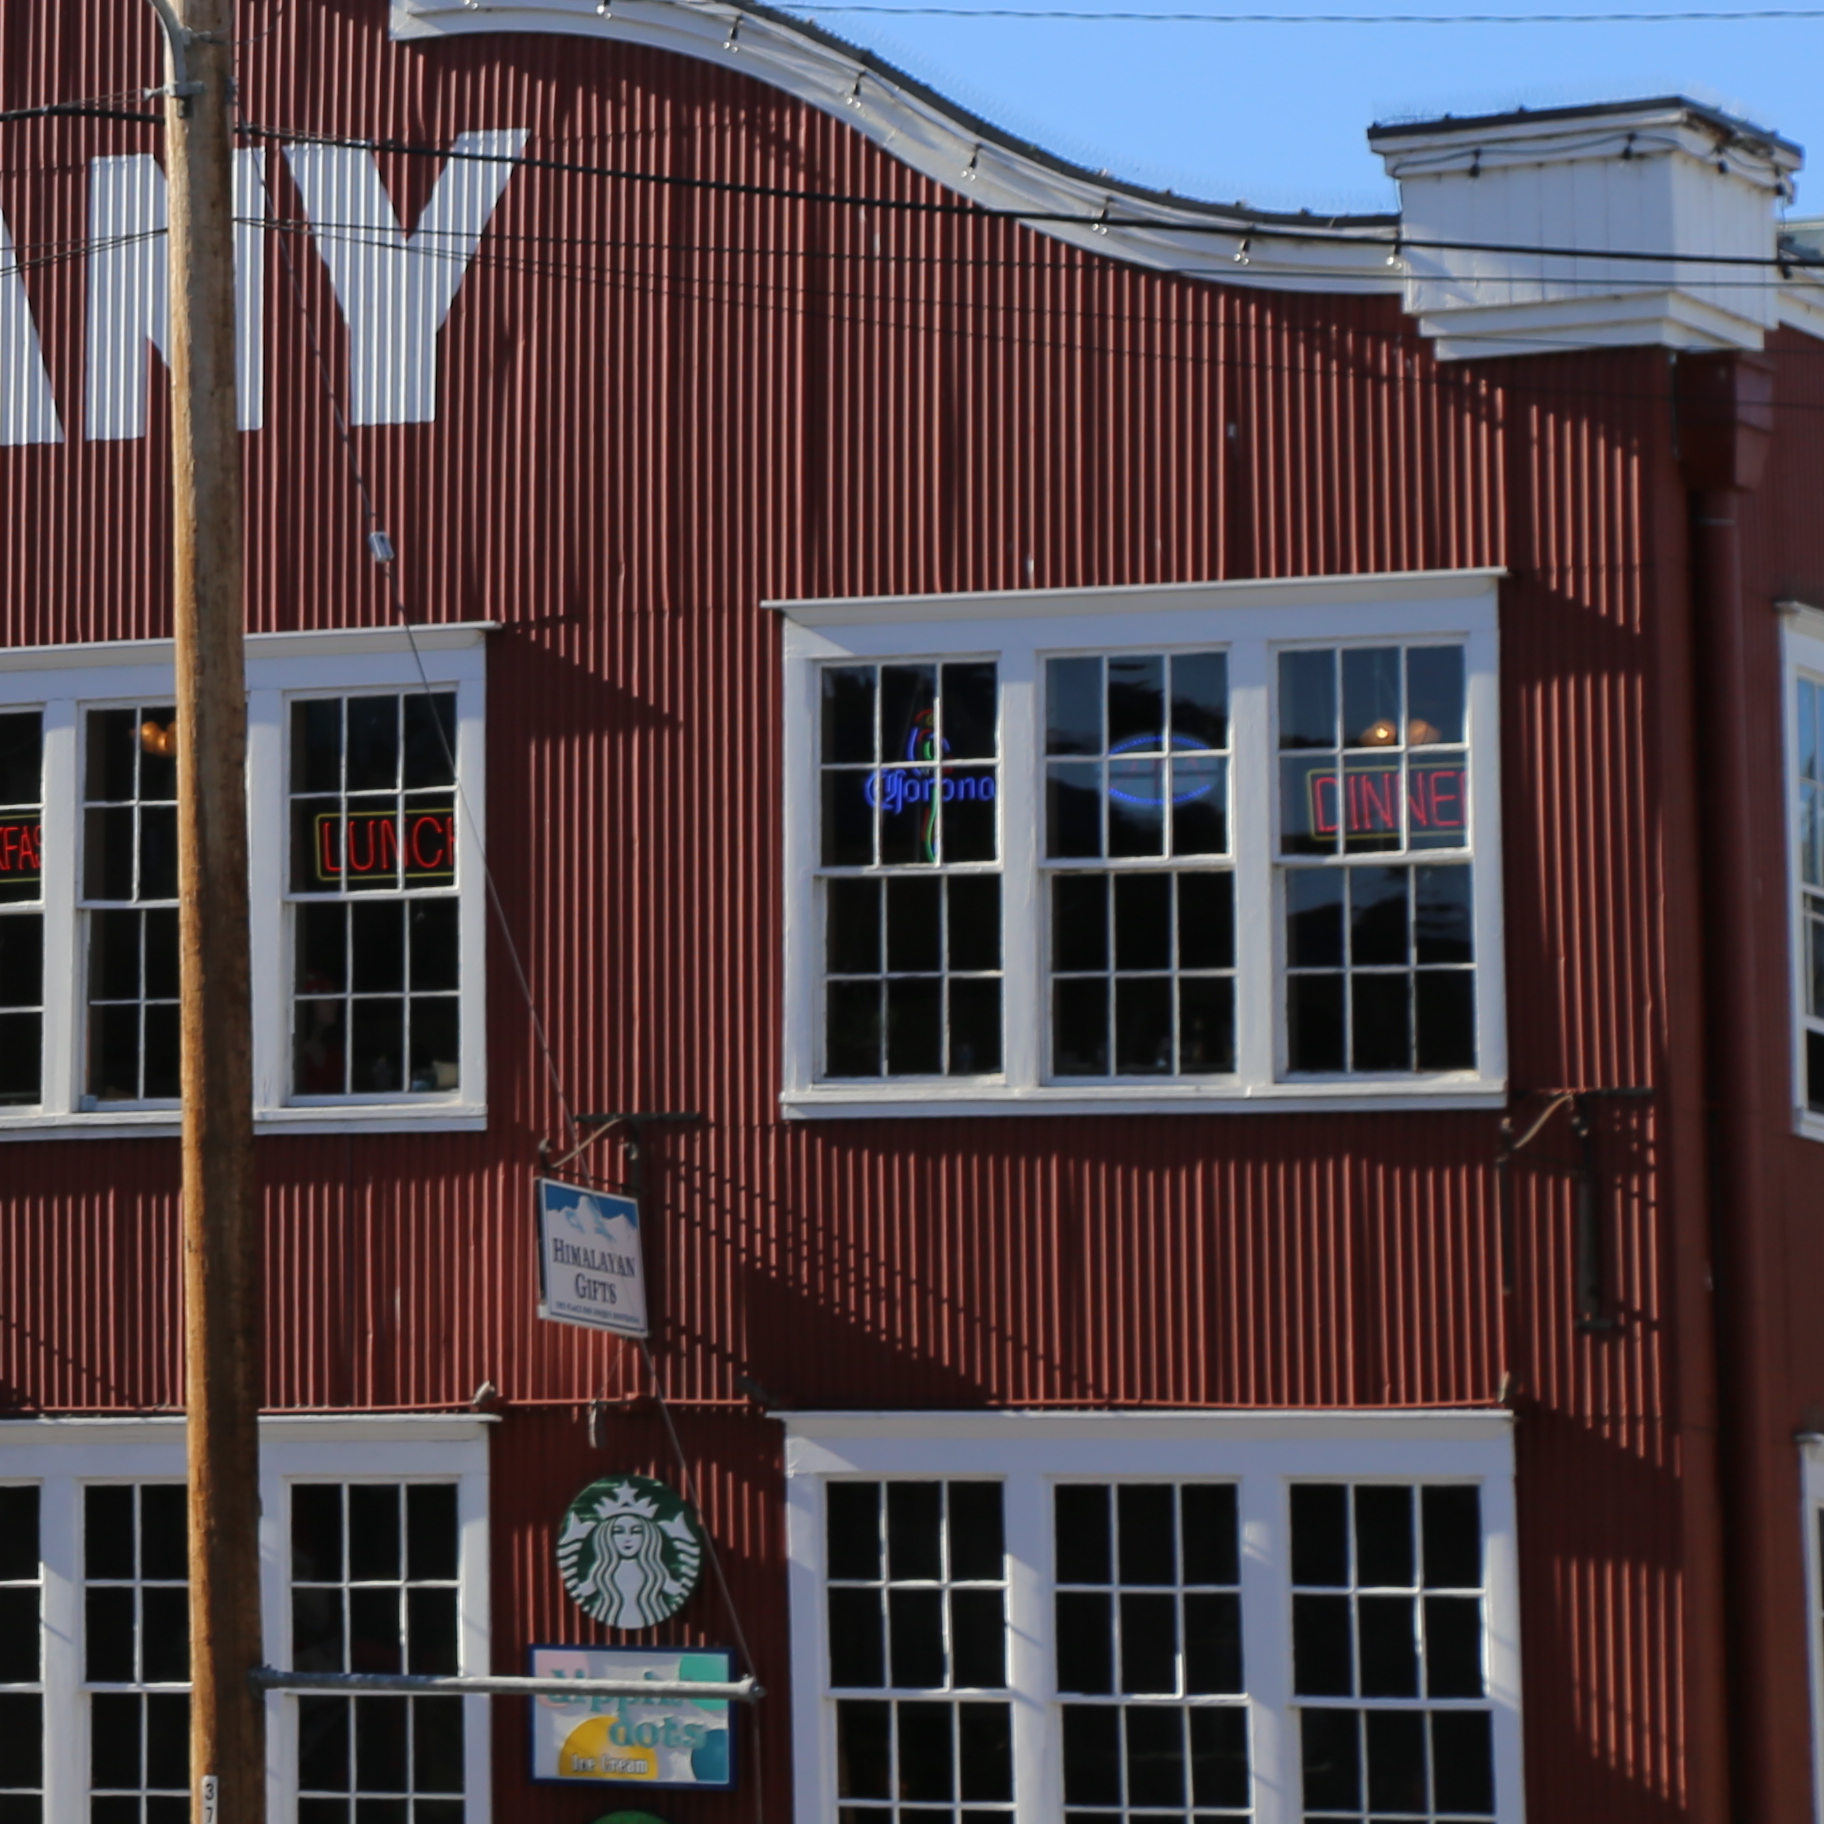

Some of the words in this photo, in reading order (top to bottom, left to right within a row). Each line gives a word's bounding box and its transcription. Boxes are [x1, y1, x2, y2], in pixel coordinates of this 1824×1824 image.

[1315, 771, 1467, 831] DINNE
[553, 1237, 636, 1278] HIMALAYAN
[574, 1272, 617, 1304] GIFTS
[609, 1714, 707, 1749] dots
[571, 1754, 595, 1773] Ice
[601, 1753, 649, 1774] Cream
